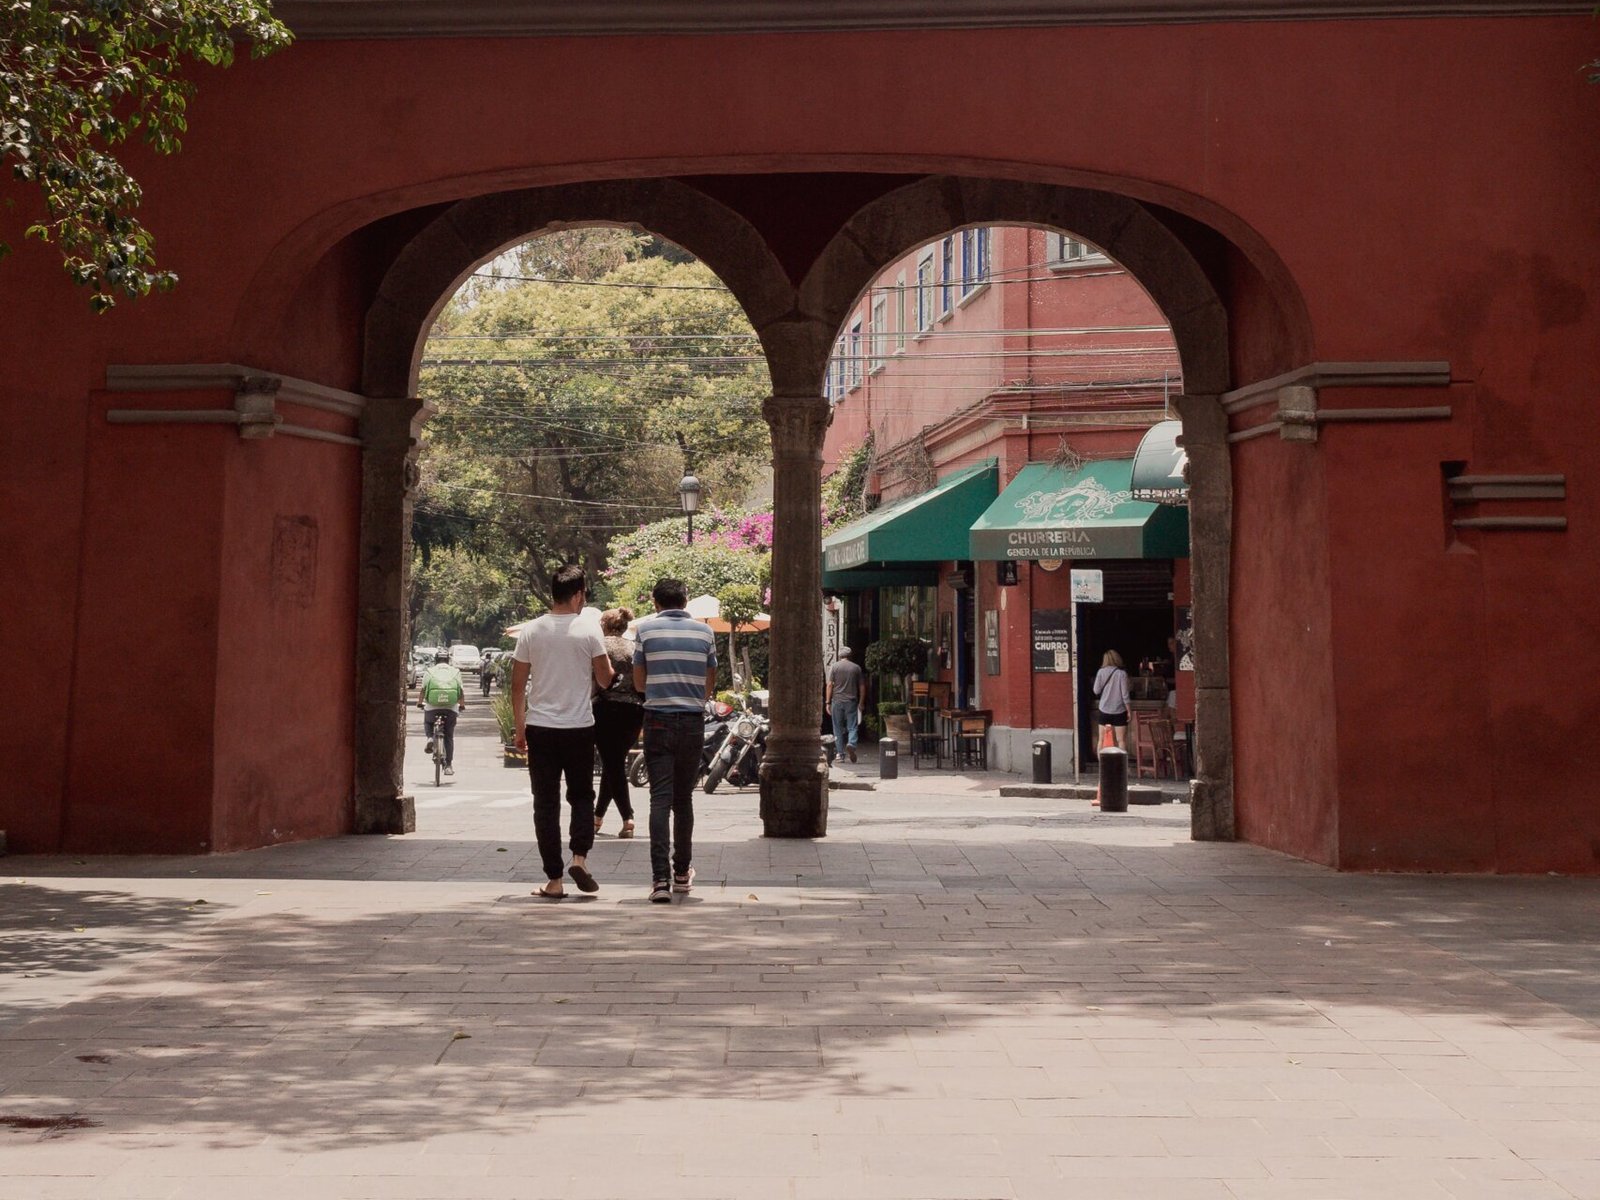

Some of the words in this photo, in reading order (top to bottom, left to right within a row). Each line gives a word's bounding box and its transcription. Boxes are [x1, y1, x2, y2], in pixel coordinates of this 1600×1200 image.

[1007, 548, 1040, 557] GENERAL
[1041, 548, 1049, 556] DE
[1050, 547, 1059, 556] LA
[1035, 642, 1069, 650] CHURRO
